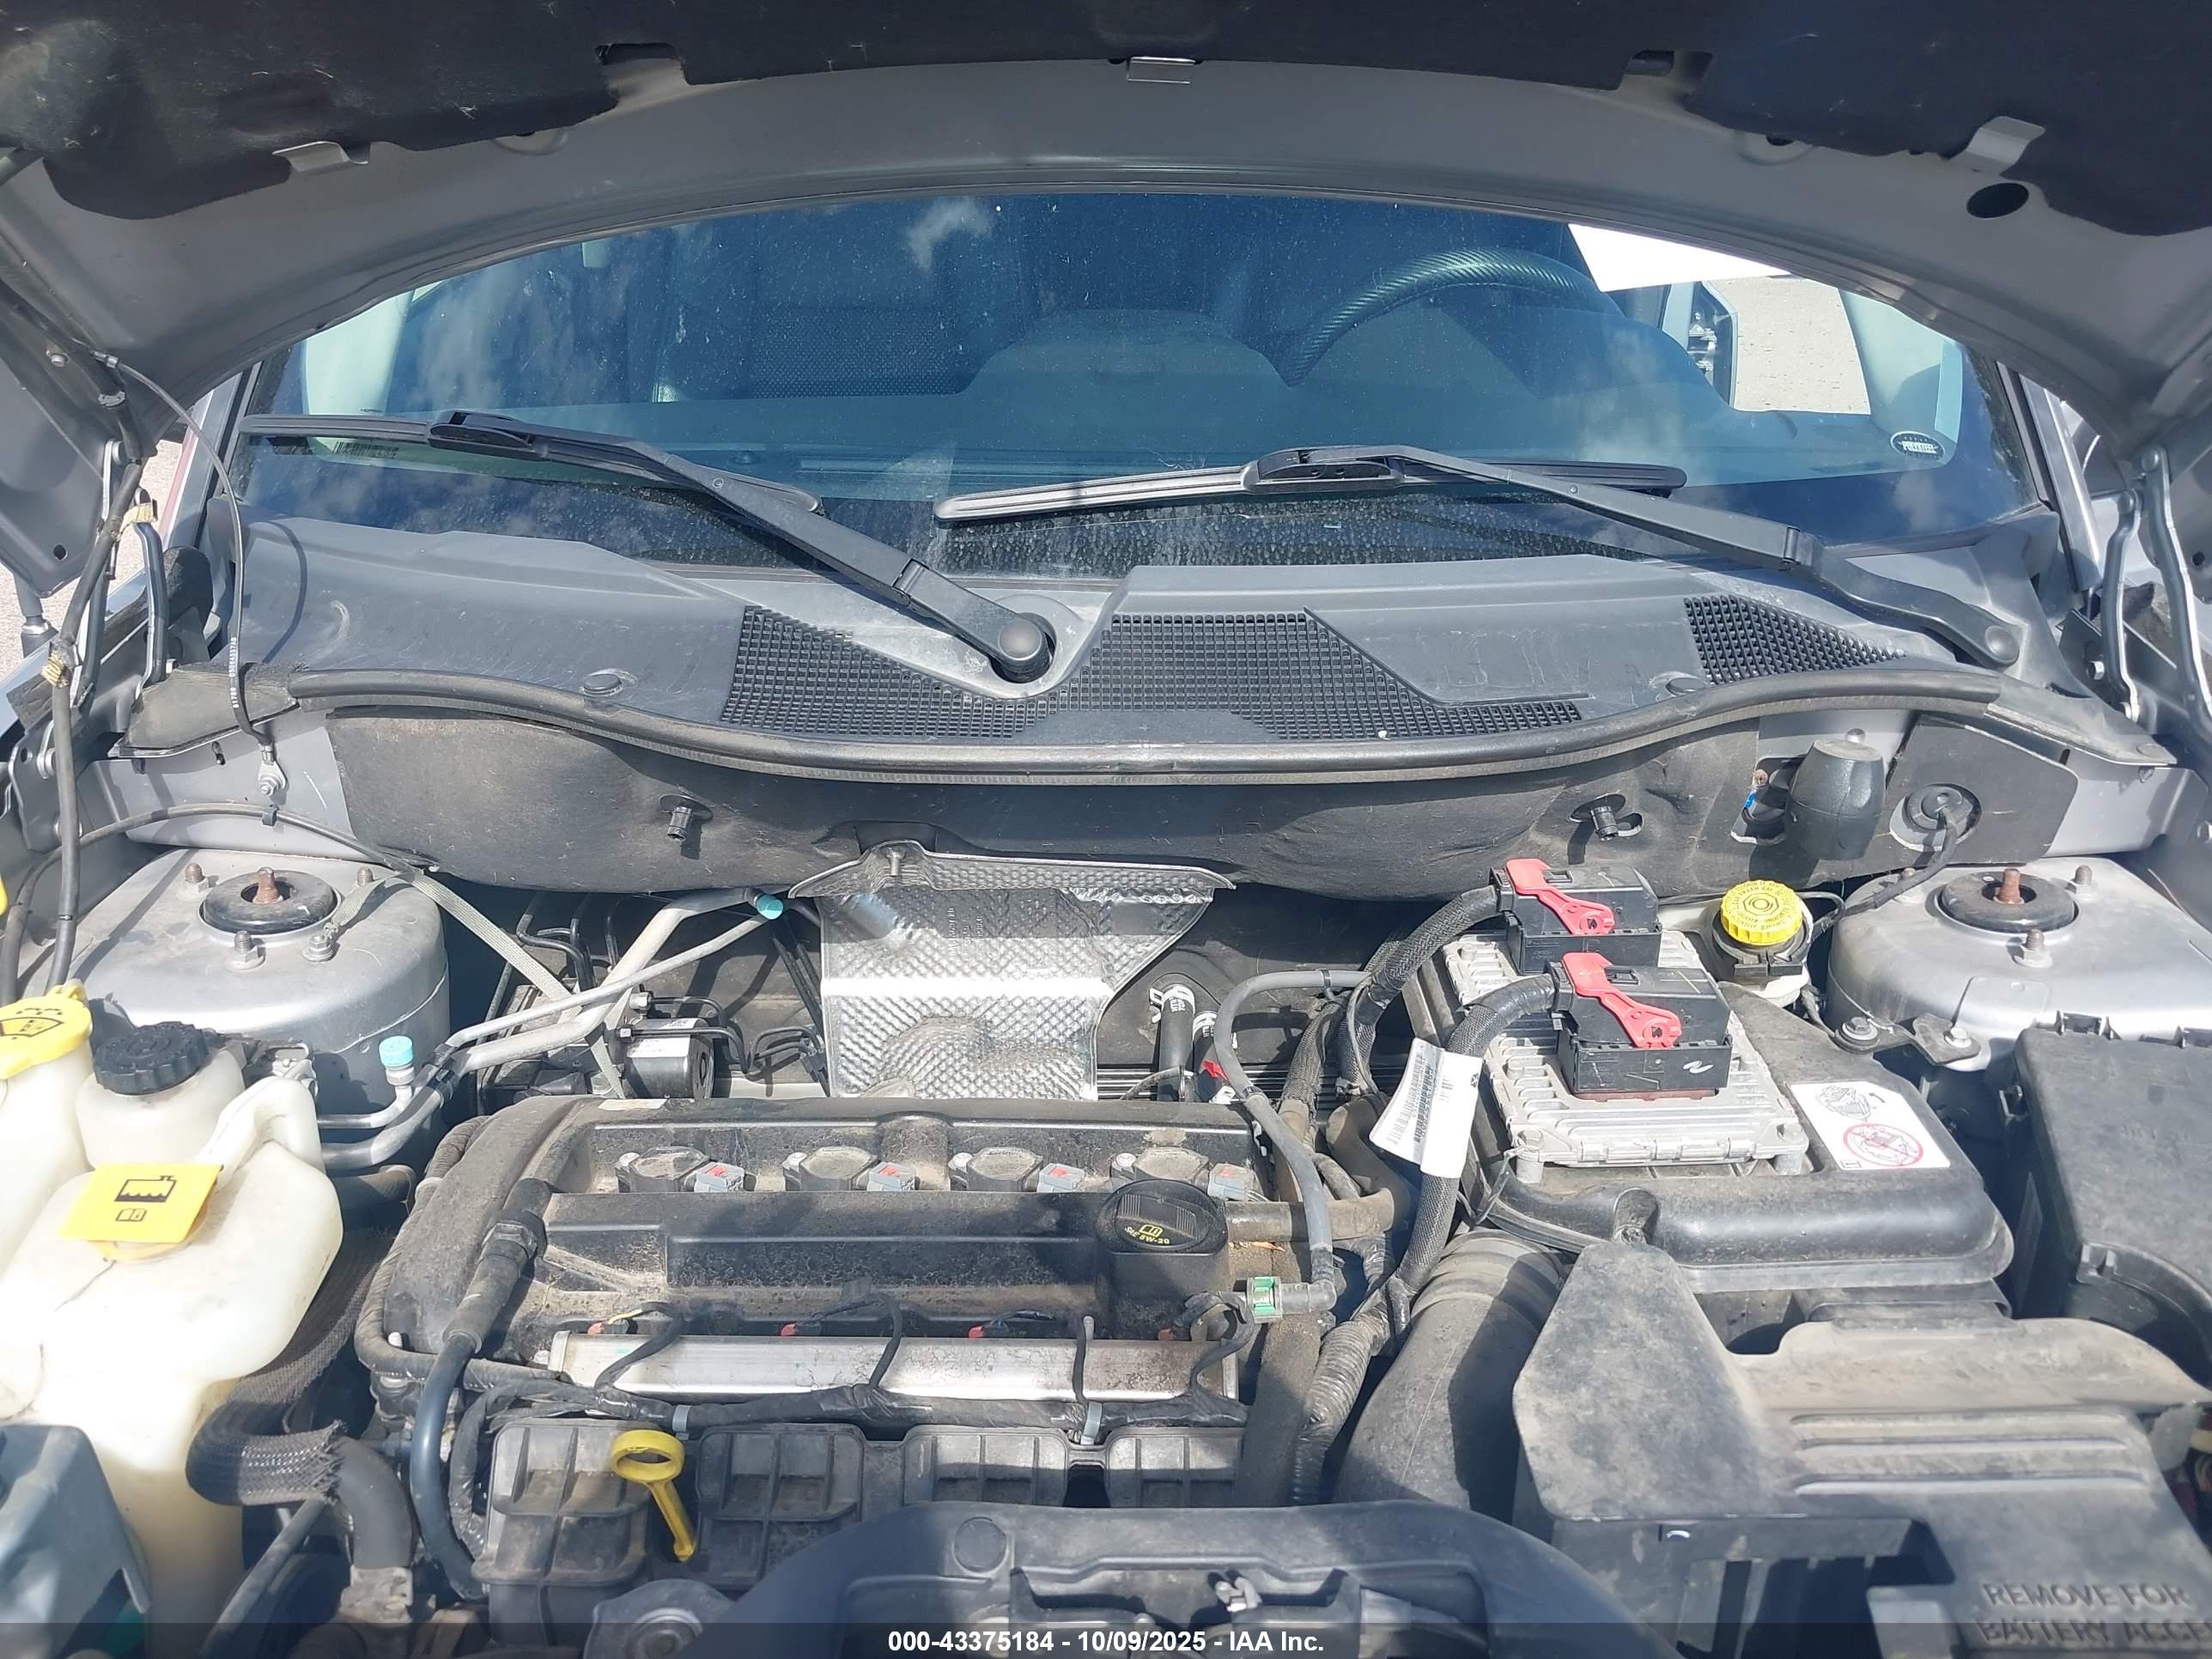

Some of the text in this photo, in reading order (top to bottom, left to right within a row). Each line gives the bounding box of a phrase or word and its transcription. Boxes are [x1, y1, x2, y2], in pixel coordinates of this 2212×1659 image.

[1124, 1226, 1170, 1243] SAE 5W-20
[1982, 1583, 2193, 1611] REMOVE FOR
[1976, 1618, 2113, 1645] BATTERY
